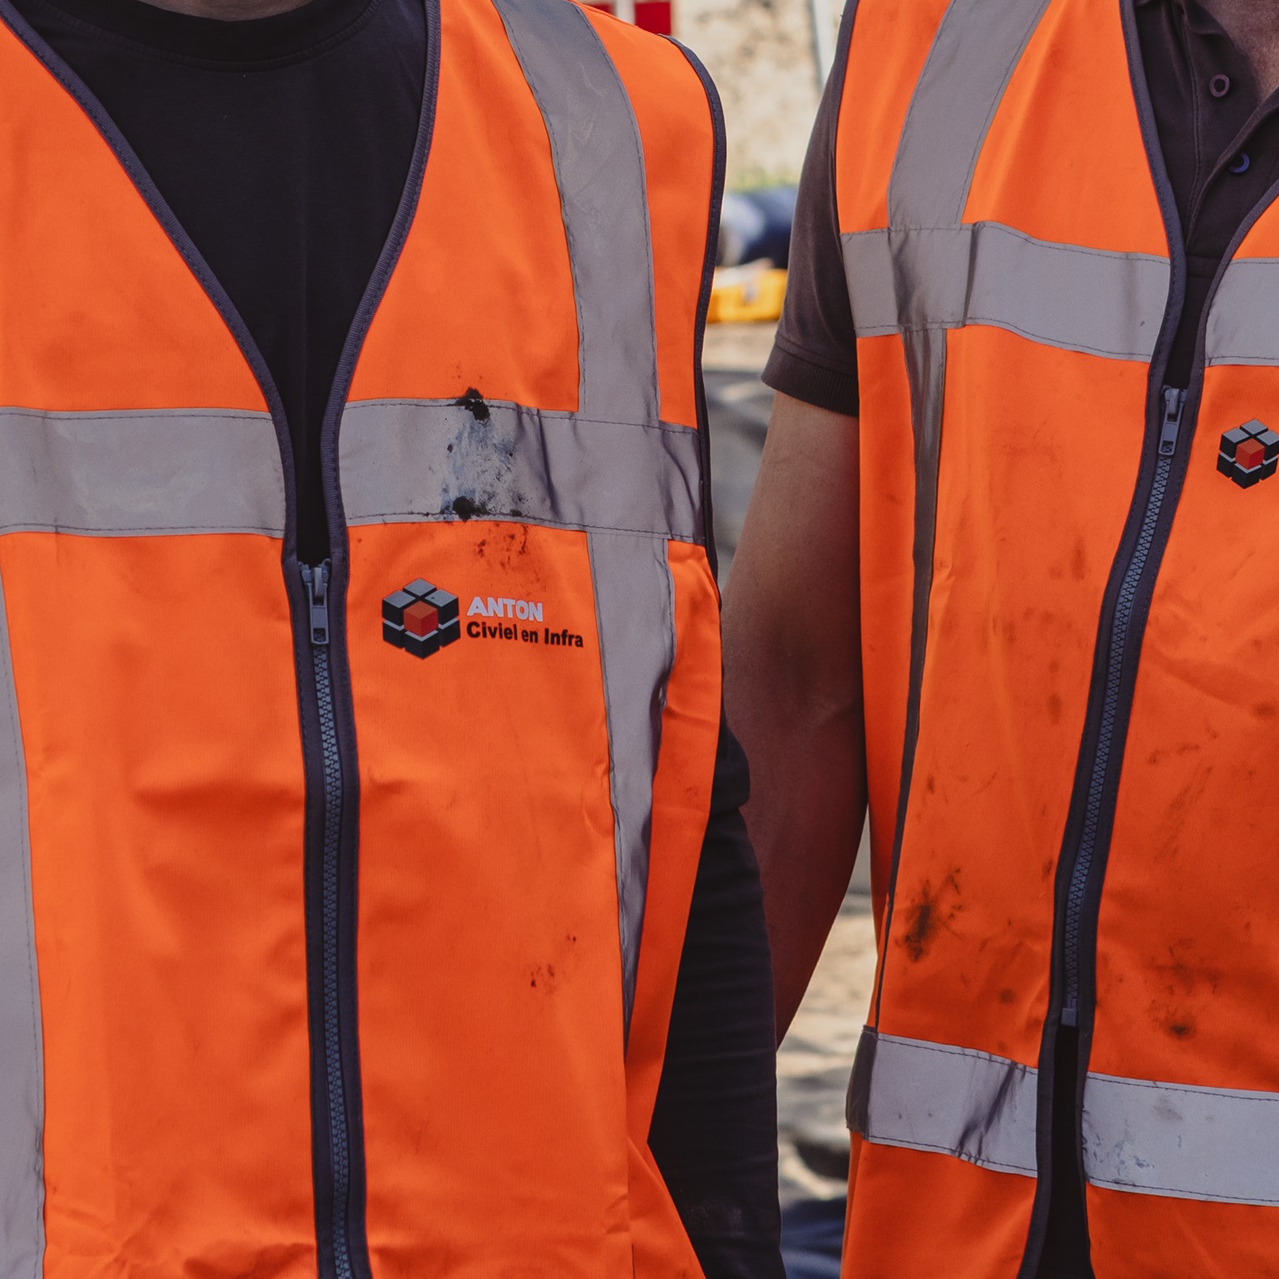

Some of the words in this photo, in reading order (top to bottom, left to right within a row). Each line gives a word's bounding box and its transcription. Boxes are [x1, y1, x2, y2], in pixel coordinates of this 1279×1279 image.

[467, 596, 544, 622] ANTON
[466, 621, 518, 640] Civiel
[521, 629, 539, 644] en
[544, 628, 584, 648] Infra
